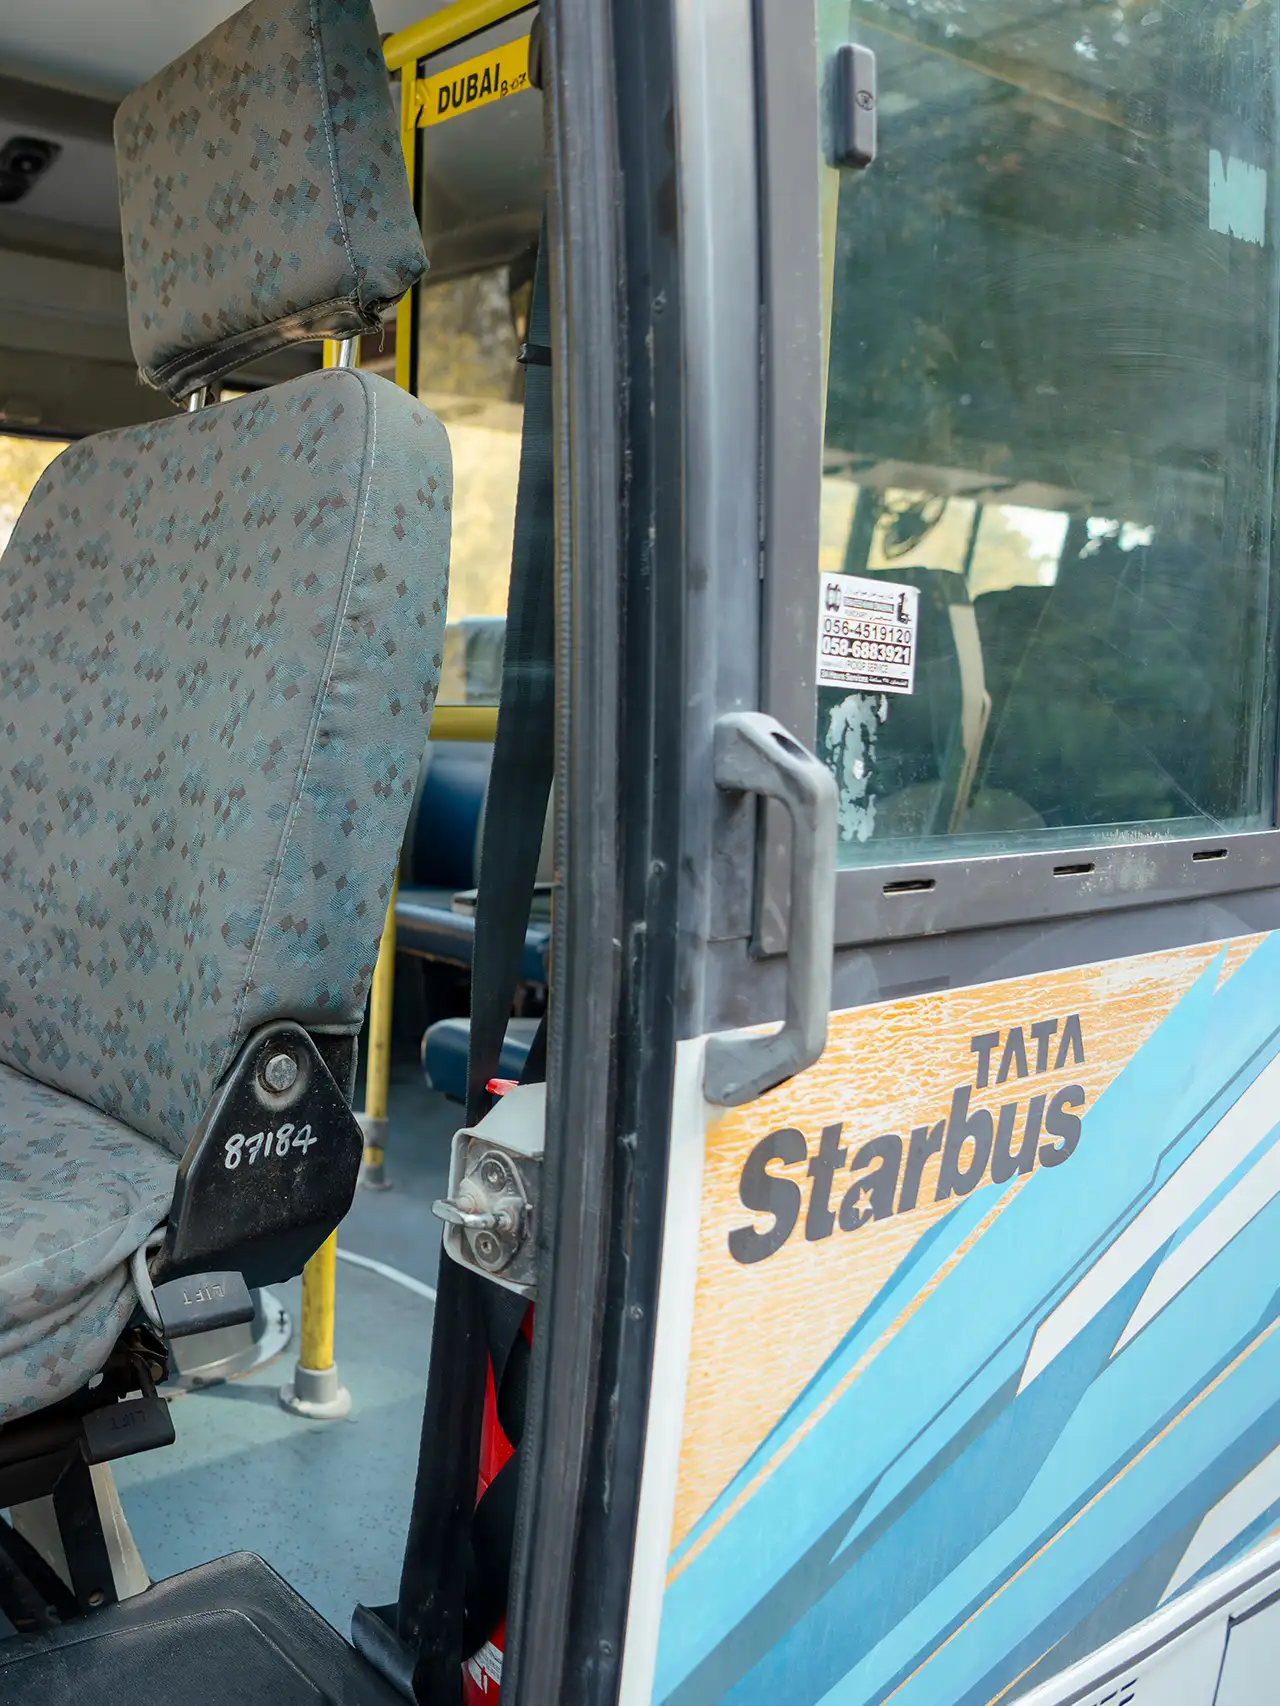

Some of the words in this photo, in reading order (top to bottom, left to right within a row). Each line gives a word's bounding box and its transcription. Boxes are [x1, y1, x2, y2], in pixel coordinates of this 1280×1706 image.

[437, 63, 500, 115] DUBAI
[824, 618, 911, 644] 056-4519120
[821, 636, 910, 665] 058-6883921
[970, 1014, 1085, 1089] TATA
[224, 1124, 317, 1170] 87184
[728, 1084, 1086, 1264] Starbus
[183, 1284, 225, 1305] LIFT
[111, 1410, 147, 1431] LIFT
